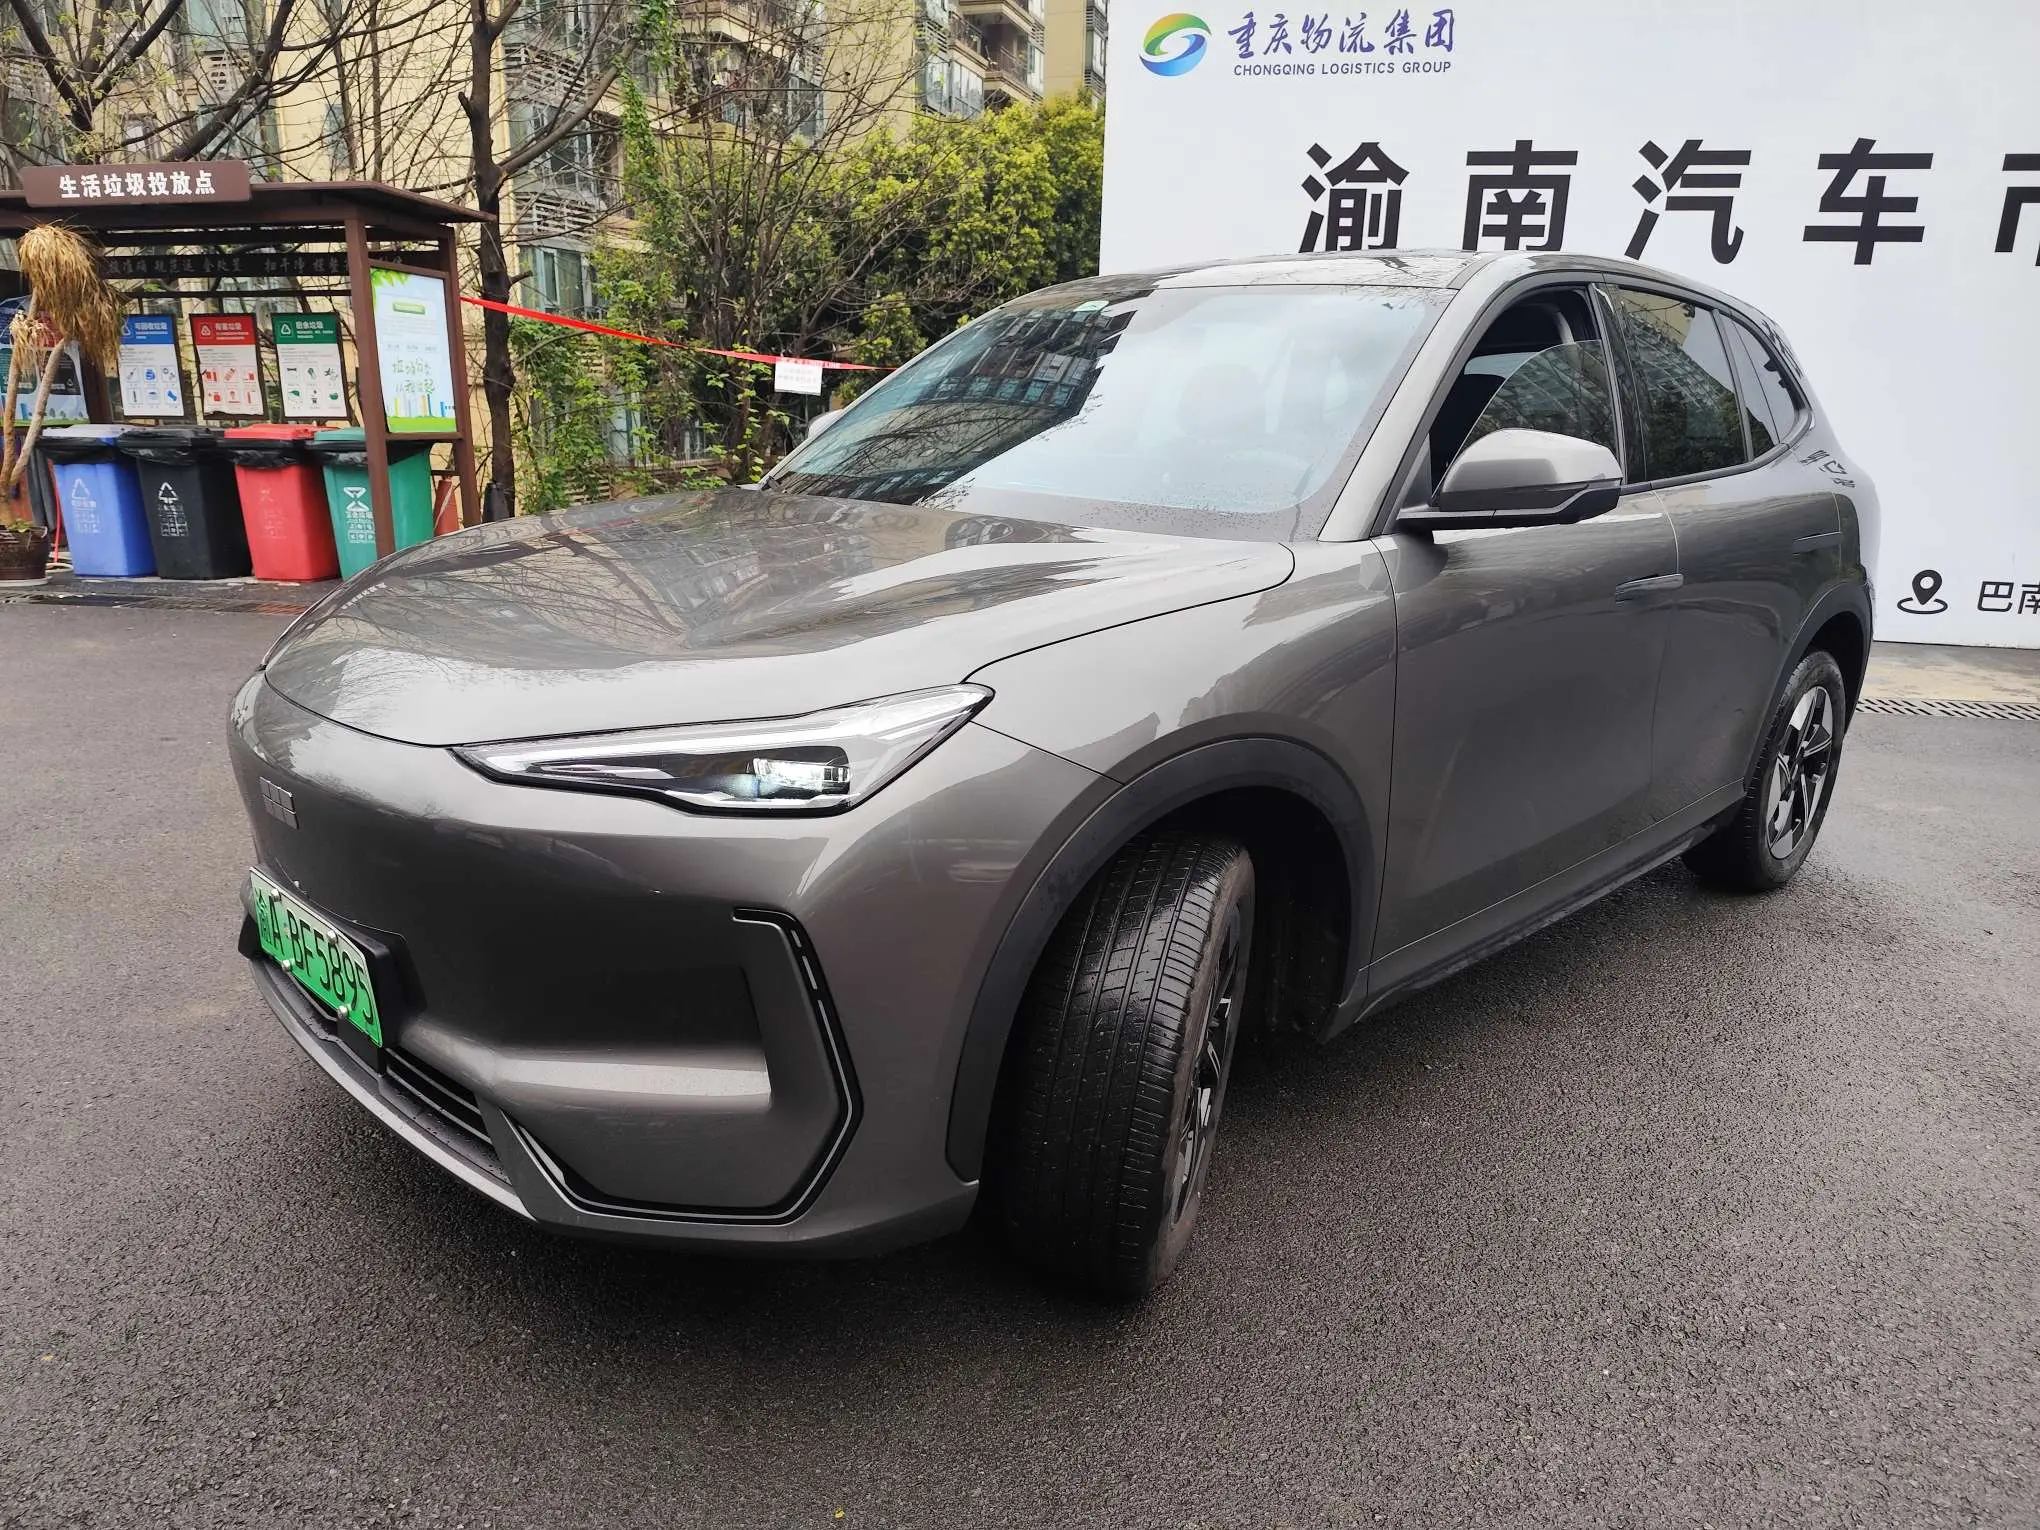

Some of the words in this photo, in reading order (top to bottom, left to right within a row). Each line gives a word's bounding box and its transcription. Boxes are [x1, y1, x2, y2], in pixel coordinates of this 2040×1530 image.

[1227, 8, 1455, 59] 重庆物流集团
[1233, 63, 1315, 76] CHONGQING
[1321, 61, 1395, 75] LOGISTICS
[1402, 60, 1452, 74] GROUP
[58, 169, 216, 198] 生活垃圾投放点
